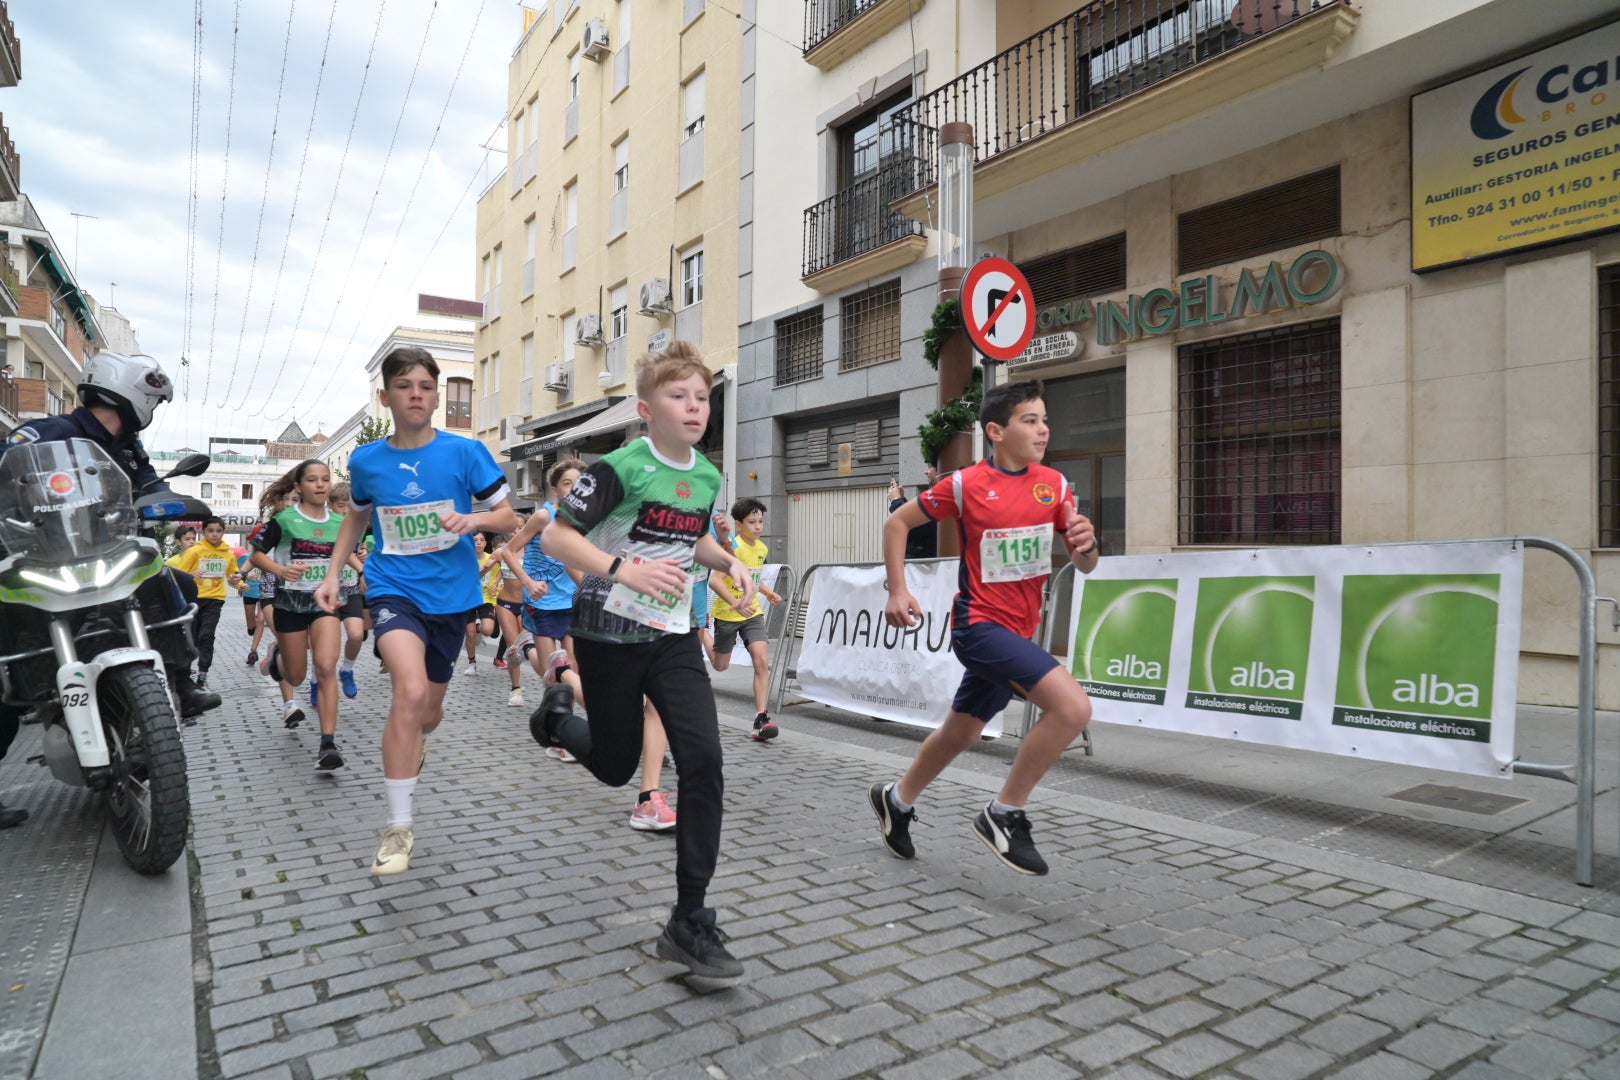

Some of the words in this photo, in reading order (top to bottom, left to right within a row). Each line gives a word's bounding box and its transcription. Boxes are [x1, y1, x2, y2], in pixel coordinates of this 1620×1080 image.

[1473, 130, 1567, 168] SEGUROS
[1425, 183, 1483, 205] Auxiliar:
[1487, 162, 1559, 188] GESTORIA
[1428, 215, 1462, 227] Tfno.
[1467, 202, 1494, 218] 924
[1499, 197, 1516, 211] 31
[1522, 190, 1541, 204] 00
[1547, 176, 1592, 198] 11/50
[1096, 250, 1341, 346] INGELMO
[1034, 346, 1043, 354] EN
[1045, 340, 1074, 353] GENERAL
[1045, 333, 1068, 345] SOCIAL
[33, 502, 72, 513] POLICIA
[71, 496, 103, 509] LOCAL
[395, 512, 441, 538] 1093
[998, 536, 1039, 564] 1151
[206, 562, 222, 573] 1013
[1106, 654, 1162, 680] alba
[1230, 661, 1295, 691] alba
[62, 693, 89, 708] 092
[1122, 690, 1156, 701] eléctricas
[1392, 673, 1480, 708] alba
[1193, 697, 1246, 711] instalaciones
[1249, 703, 1290, 715] eléctricas
[1344, 712, 1417, 730] instalaciones
[1420, 722, 1476, 736] eléctricas
